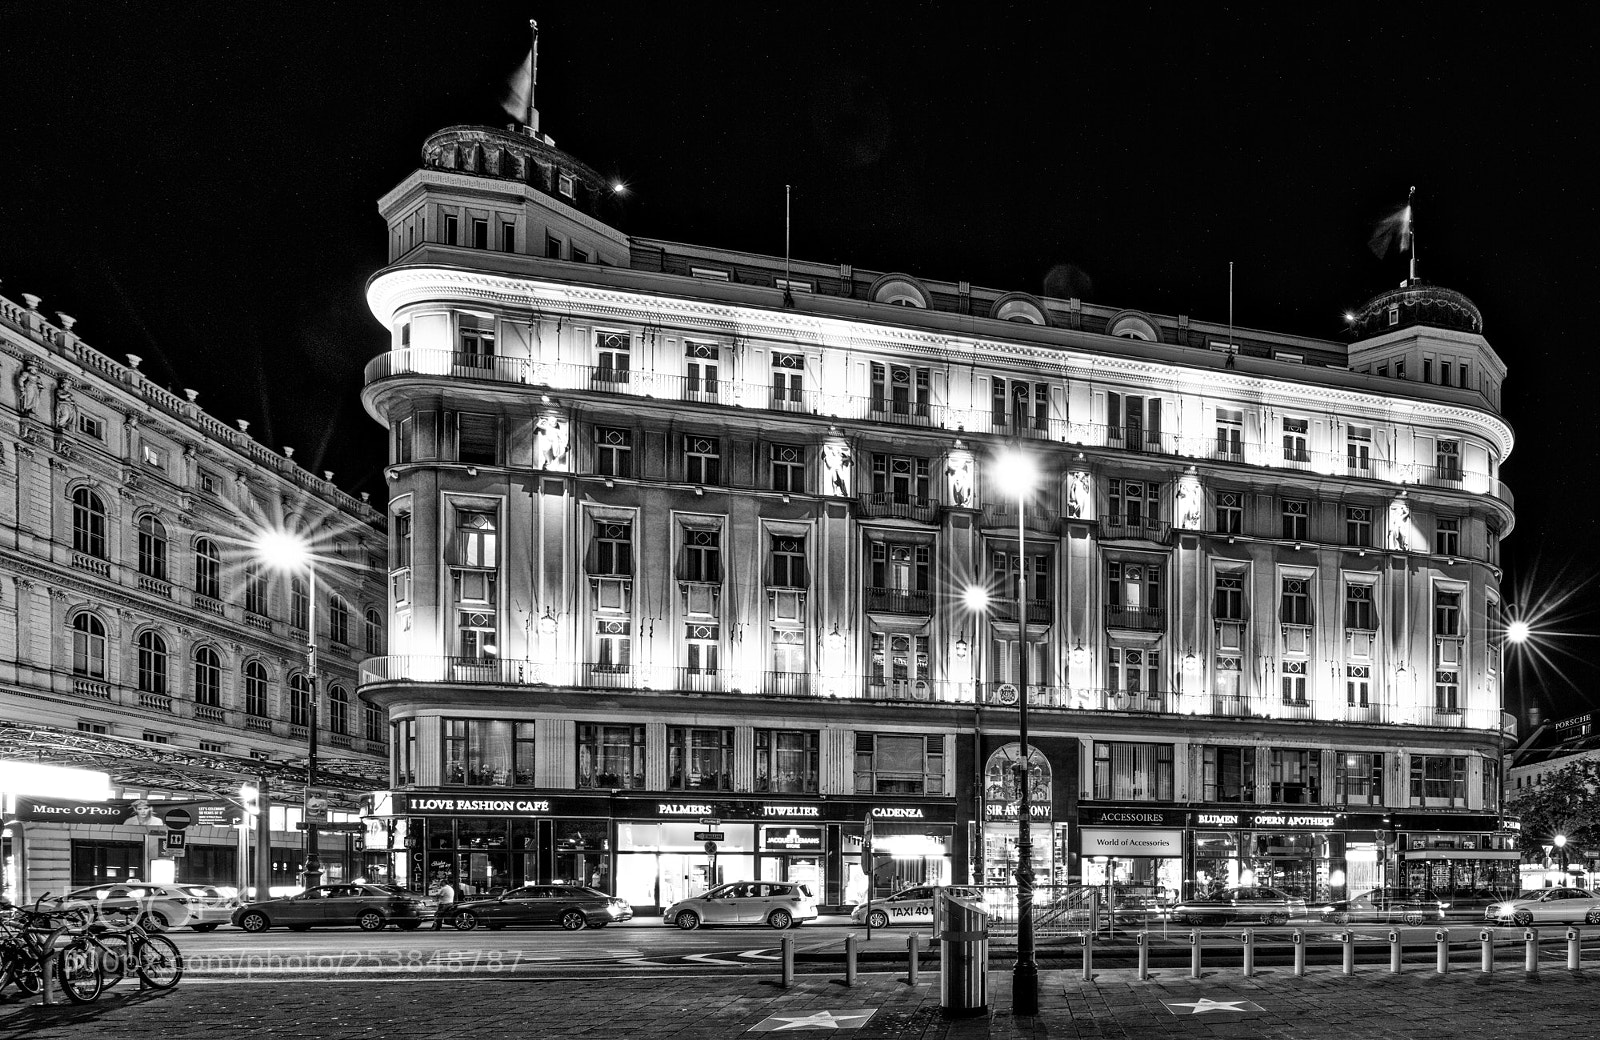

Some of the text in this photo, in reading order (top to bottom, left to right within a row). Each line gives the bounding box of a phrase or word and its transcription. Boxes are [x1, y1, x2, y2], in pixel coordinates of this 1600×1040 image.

[1555, 714, 1592, 730] PORSCHE
[33, 805, 120, 816] Marc O'Polo
[411, 800, 549, 811] I LOVE FASHION CAFÉ
[659, 805, 712, 814] PALMERS
[763, 806, 819, 816] JUWELIER
[872, 808, 924, 818] CADENZA
[987, 805, 1051, 817] SIR ANONY
[1101, 813, 1164, 822] ACCESSOIRES
[1198, 815, 1238, 824] BLUMEN
[1254, 816, 1335, 826] OPERN APOTHEKE
[1097, 838, 1170, 847] World of Accessories
[890, 906, 934, 917] TAXI 401
